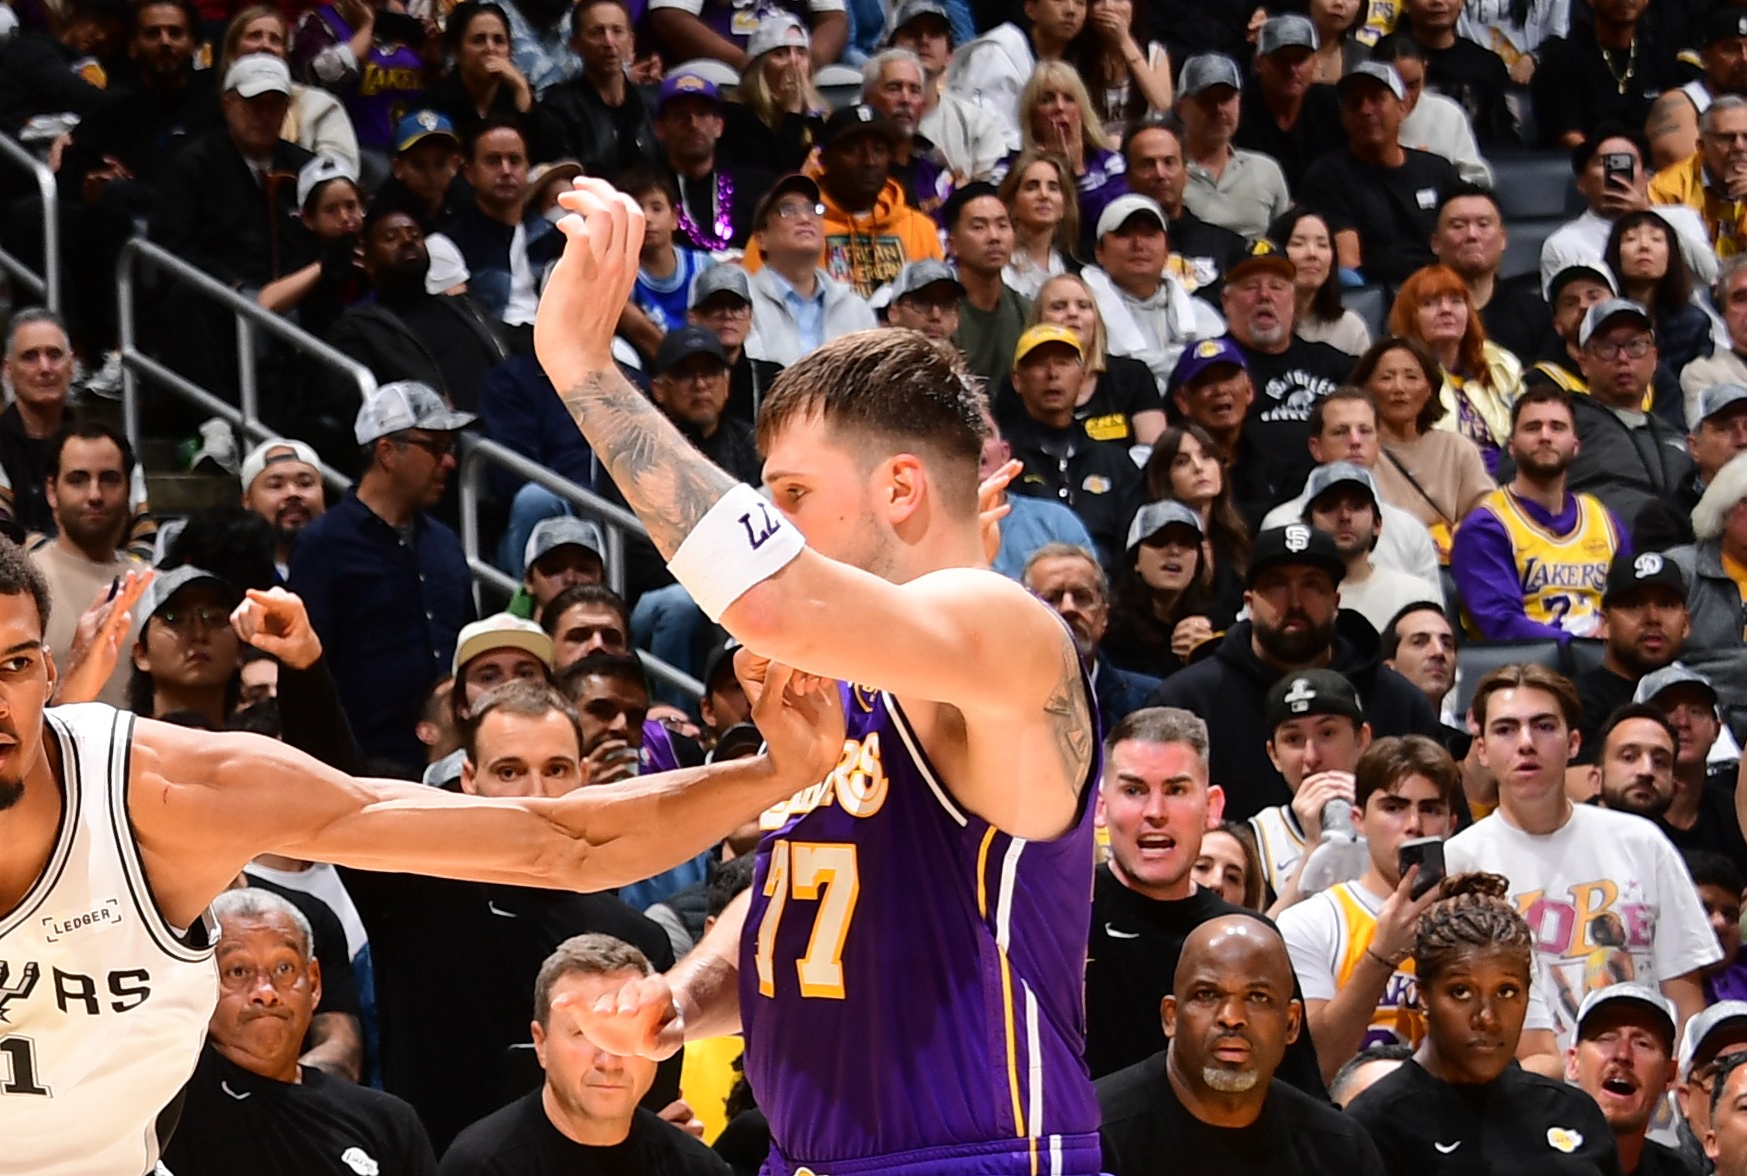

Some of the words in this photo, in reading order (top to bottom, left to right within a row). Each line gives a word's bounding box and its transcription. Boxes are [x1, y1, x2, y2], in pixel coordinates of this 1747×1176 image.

[1522, 556, 1608, 596] LAKERS
[54, 907, 111, 935] LEDGER
[755, 838, 860, 999] 77
